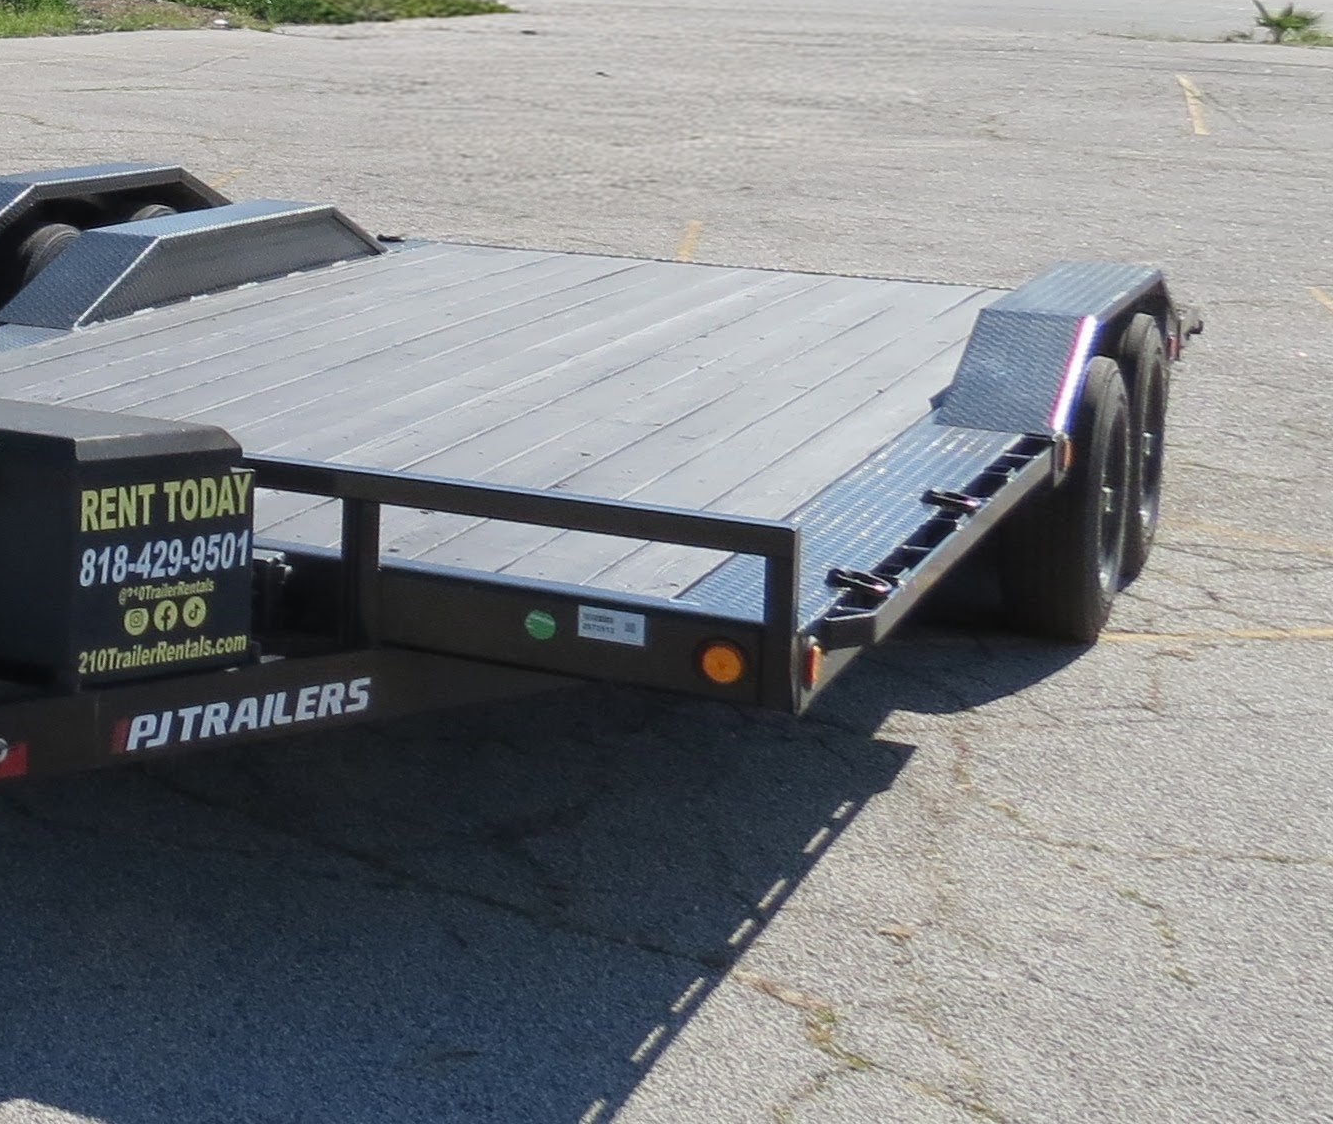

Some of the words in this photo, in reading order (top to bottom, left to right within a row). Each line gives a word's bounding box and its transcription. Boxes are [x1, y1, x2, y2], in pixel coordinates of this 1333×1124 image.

[80, 483, 156, 532] RENT
[163, 473, 252, 523] TODAY
[79, 529, 250, 587] 818-429-9501
[78, 634, 247, 674] 210TrailerRentals.com
[177, 677, 372, 743] TRAILERS
